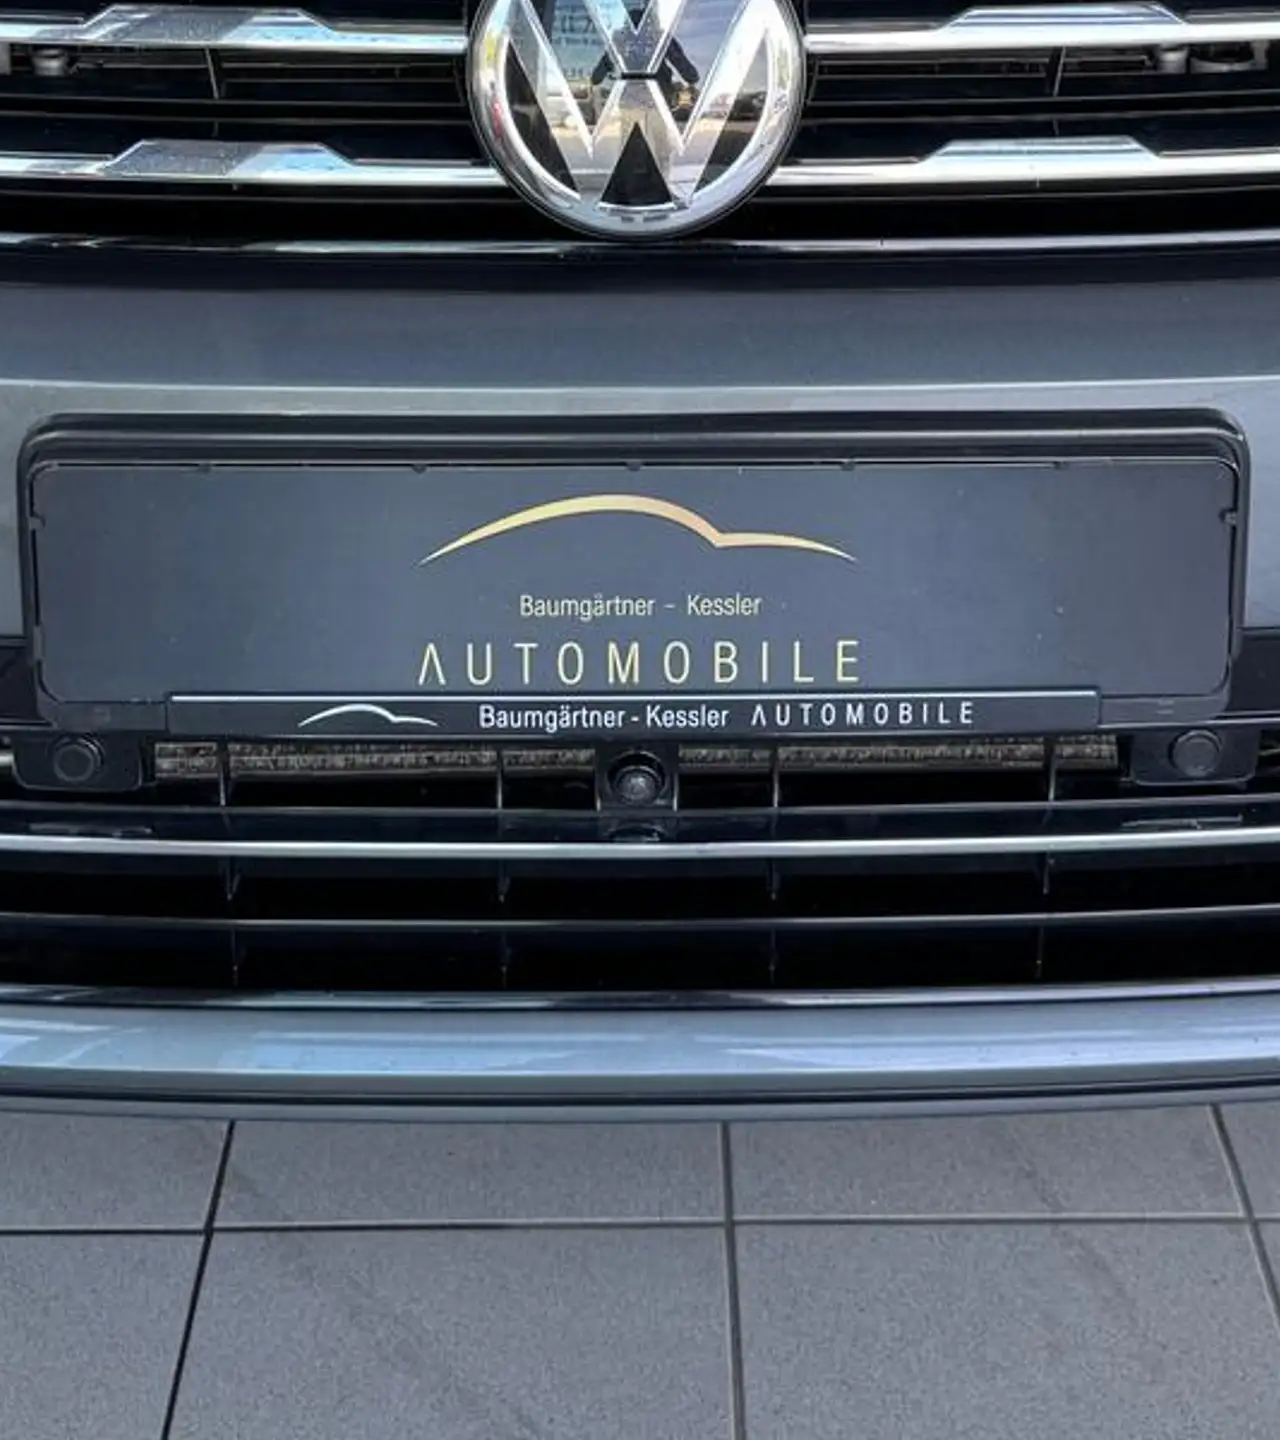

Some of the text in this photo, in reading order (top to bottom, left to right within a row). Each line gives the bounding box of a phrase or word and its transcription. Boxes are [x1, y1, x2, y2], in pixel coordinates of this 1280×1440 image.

[519, 593, 655, 621] Baumgärtner
[686, 593, 762, 617] Kessler
[418, 640, 861, 686] AUTOMOBILE
[478, 703, 626, 734] Baumgärtner
[645, 704, 729, 728] Kessler
[751, 701, 975, 727] AUTOMOBILE
